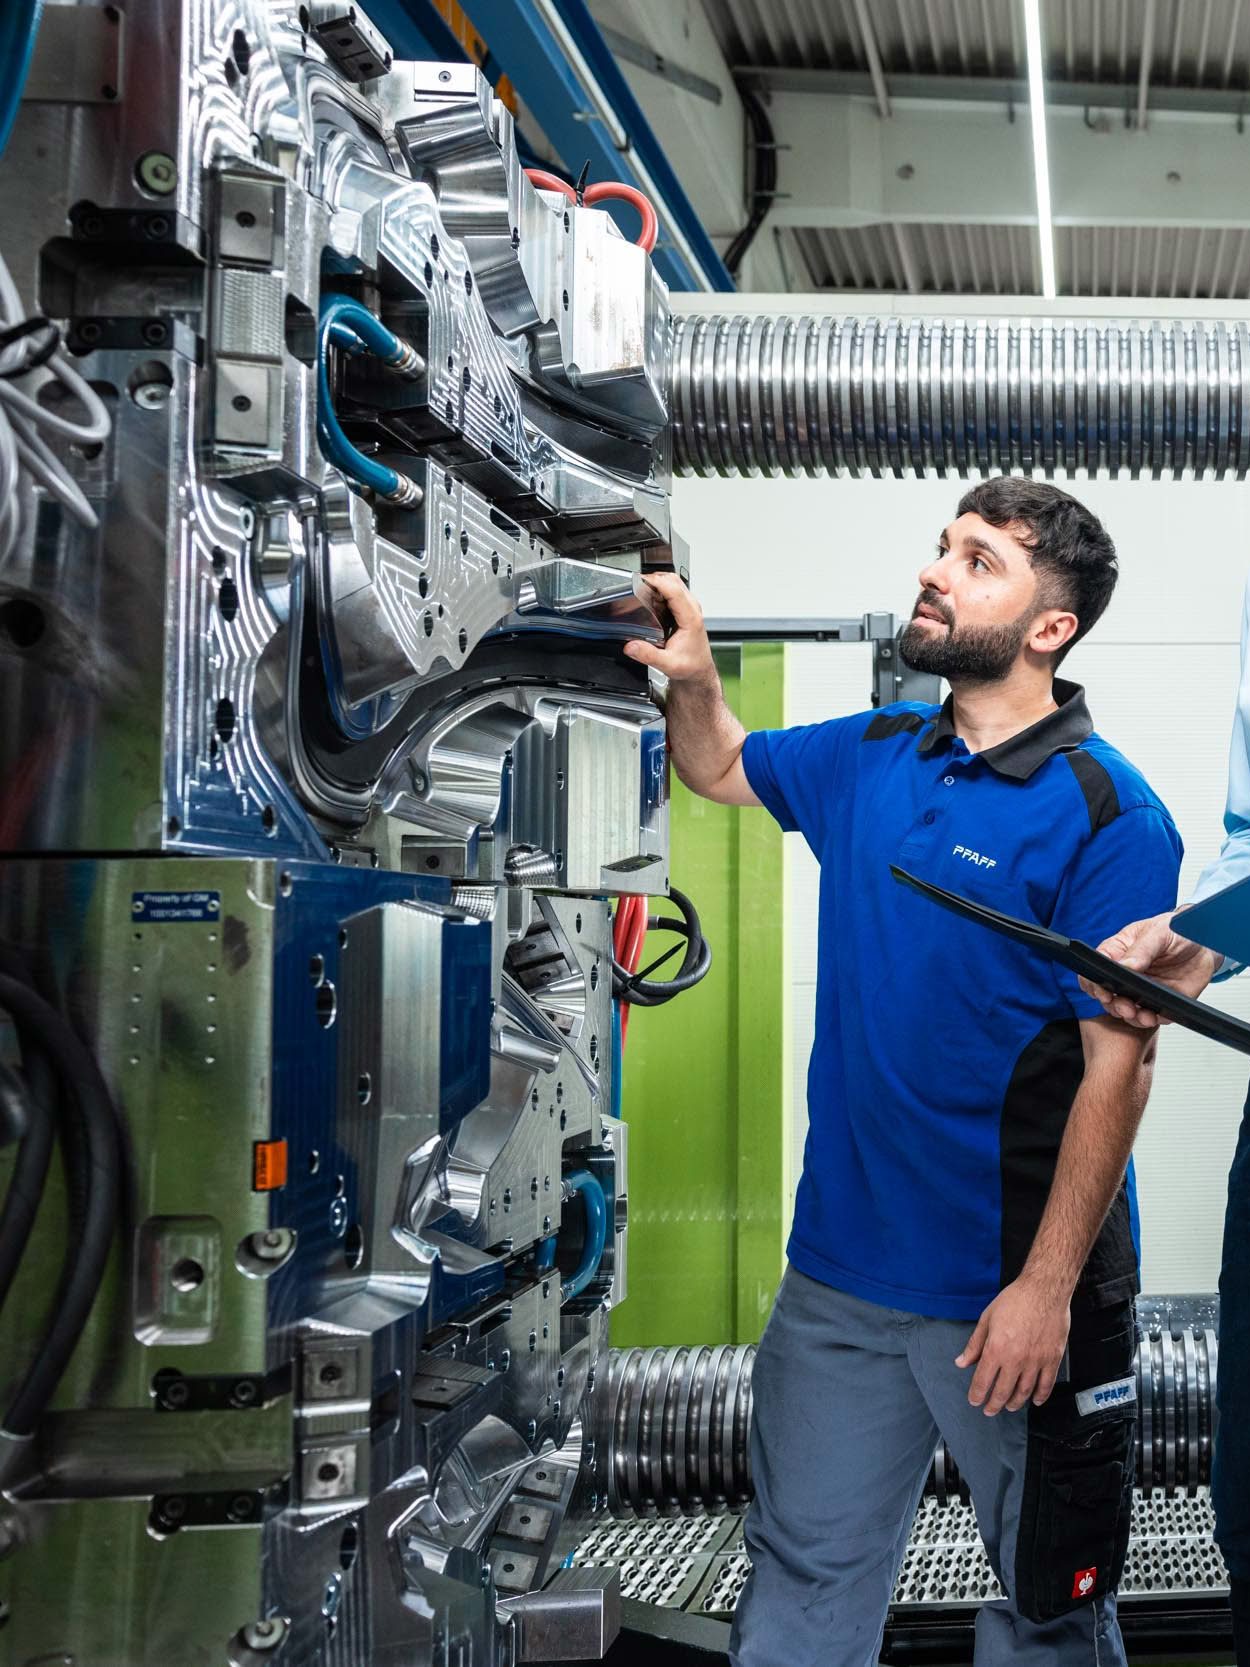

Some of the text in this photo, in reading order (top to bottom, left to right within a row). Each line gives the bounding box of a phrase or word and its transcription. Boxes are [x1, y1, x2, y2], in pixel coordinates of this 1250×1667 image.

[952, 845, 997, 869] PFAFF
[143, 894, 180, 904] Property
[182, 893, 192, 903] of
[1094, 1386, 1129, 1405] PFAFF
